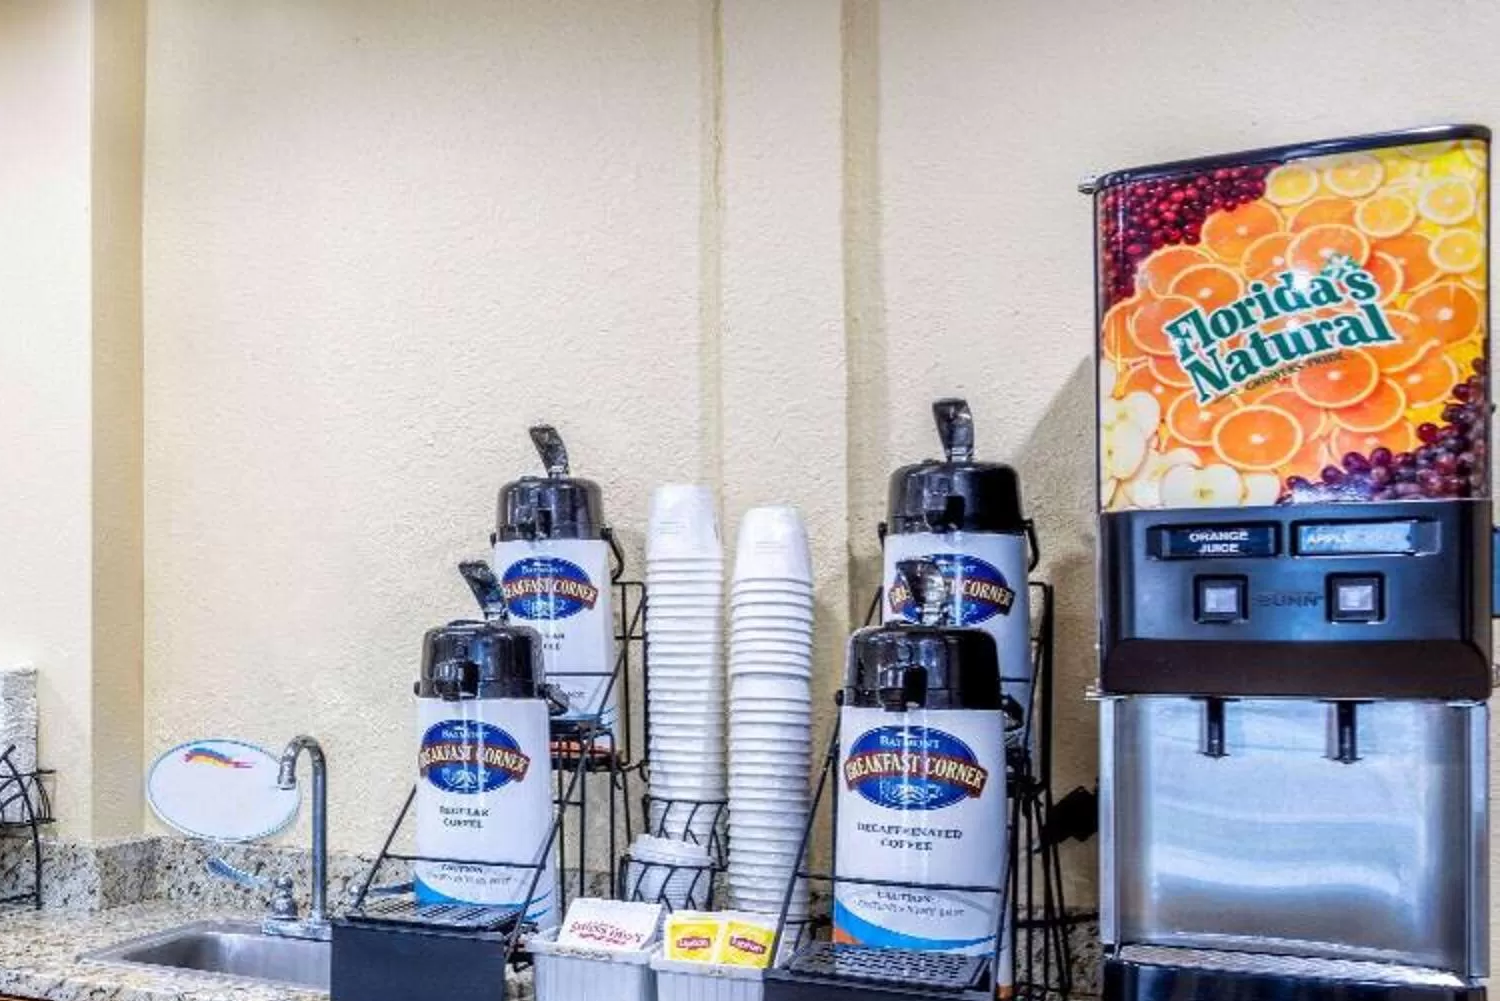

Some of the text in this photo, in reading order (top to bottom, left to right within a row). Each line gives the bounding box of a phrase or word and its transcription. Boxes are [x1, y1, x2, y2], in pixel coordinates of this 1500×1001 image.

[1165, 264, 1377, 361] Florida's
[1184, 304, 1396, 401] Natural
[1189, 531, 1249, 543] ORANGE
[1199, 543, 1240, 553] JUICE
[879, 735, 940, 749] BAYMONT
[846, 752, 983, 789] BREAKFAST CORNER
[880, 839, 933, 851] COFFEE
